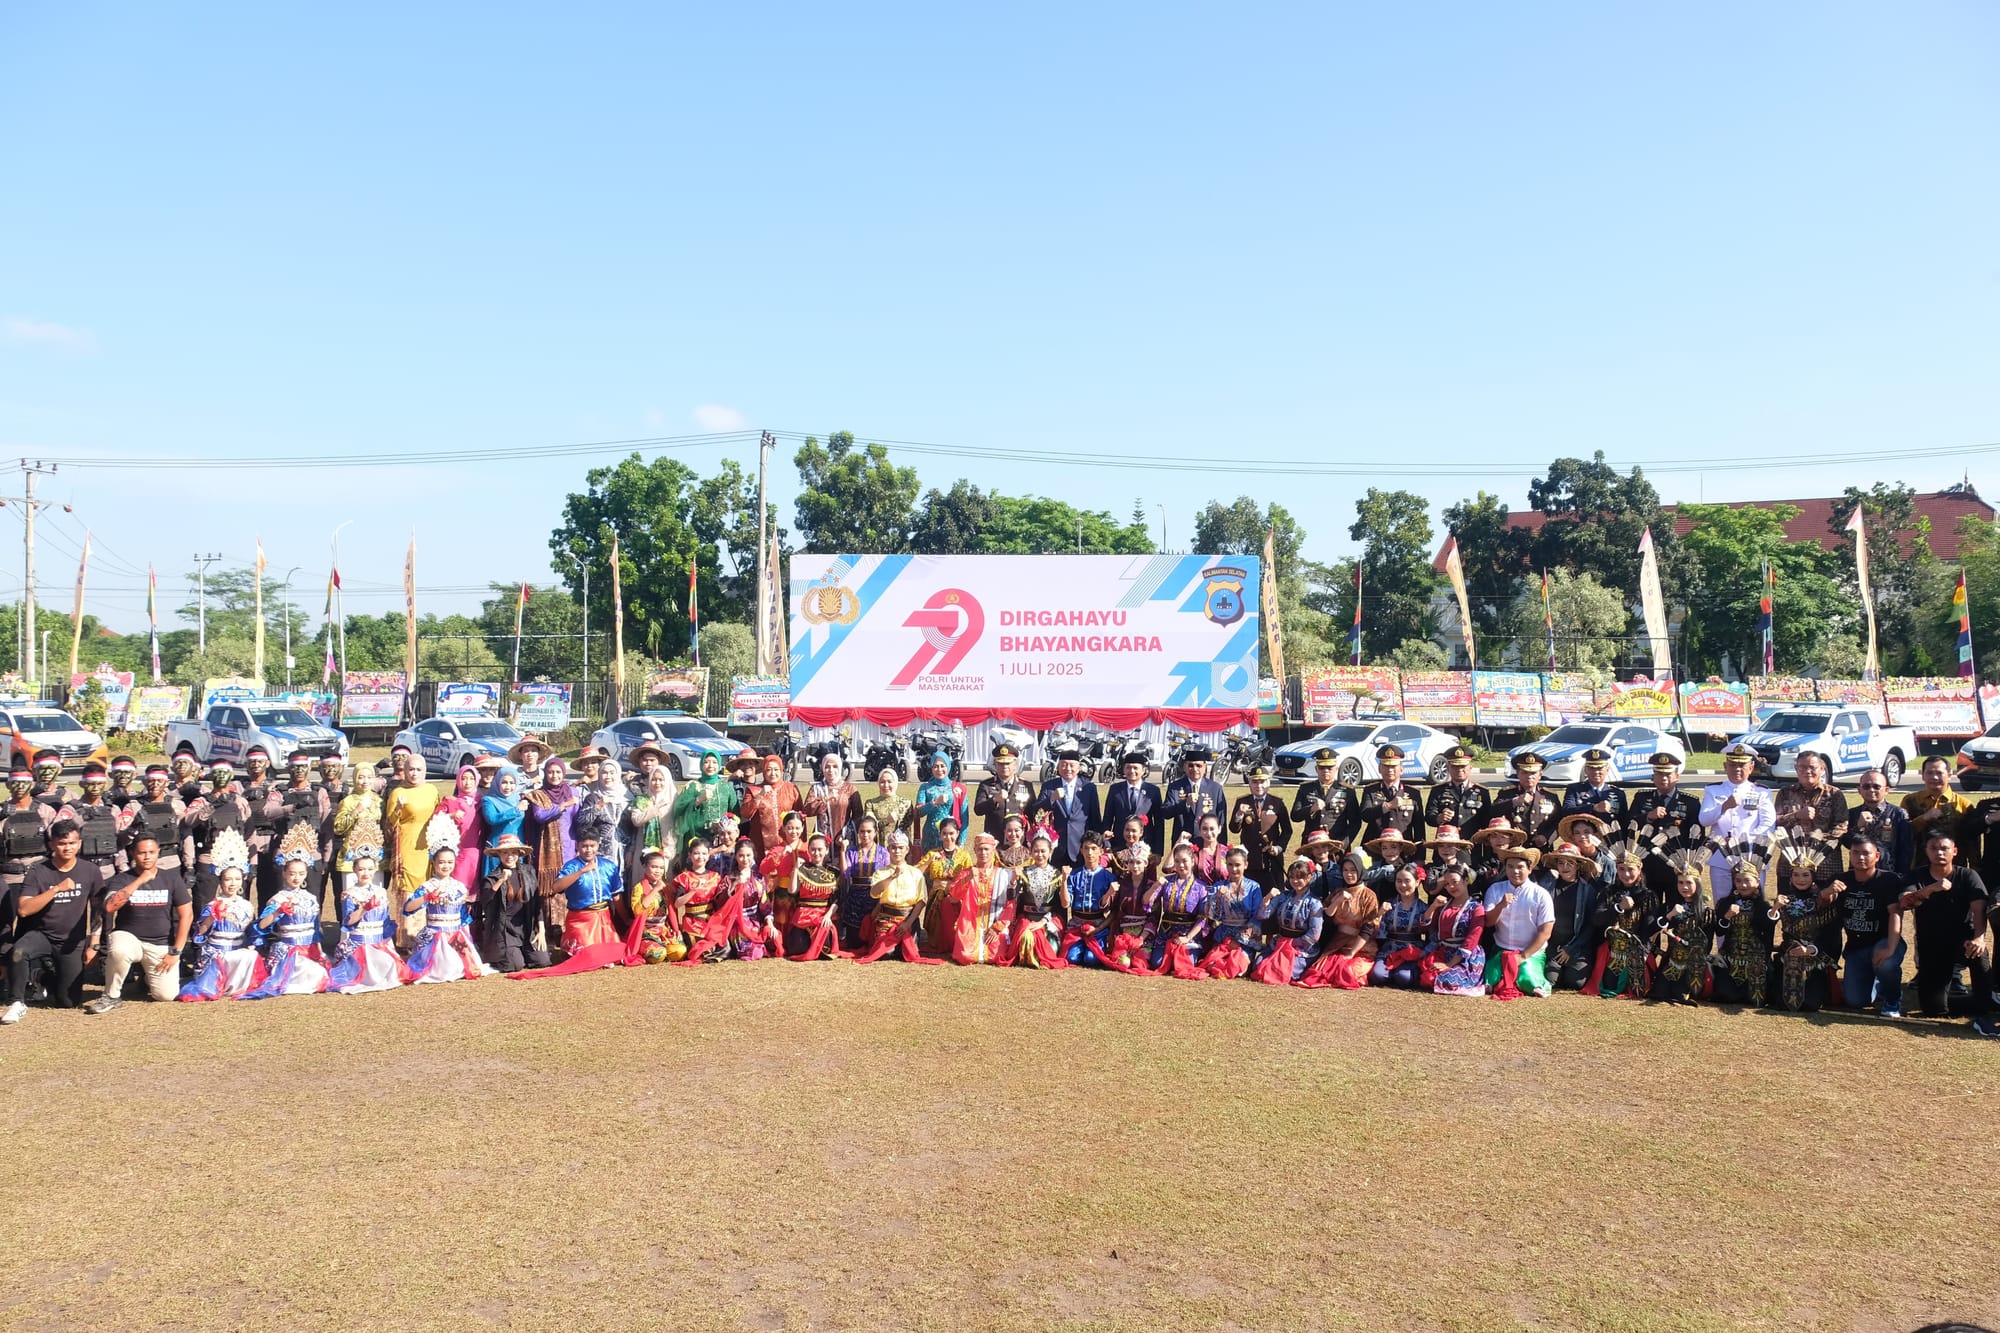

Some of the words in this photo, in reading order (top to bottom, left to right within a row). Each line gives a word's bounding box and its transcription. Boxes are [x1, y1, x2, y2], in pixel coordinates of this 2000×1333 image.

[1000, 611, 1127, 626] DIRGAHAYU
[1000, 636, 1163, 652] BHAYANGKARA
[1000, 663, 1005, 675] 1
[1010, 662, 1042, 676] JULI
[1047, 663, 1084, 676] 2025
[918, 675, 948, 683] POLRI
[951, 675, 985, 683] UNTUK
[918, 684, 985, 692] MASYARAKAT
